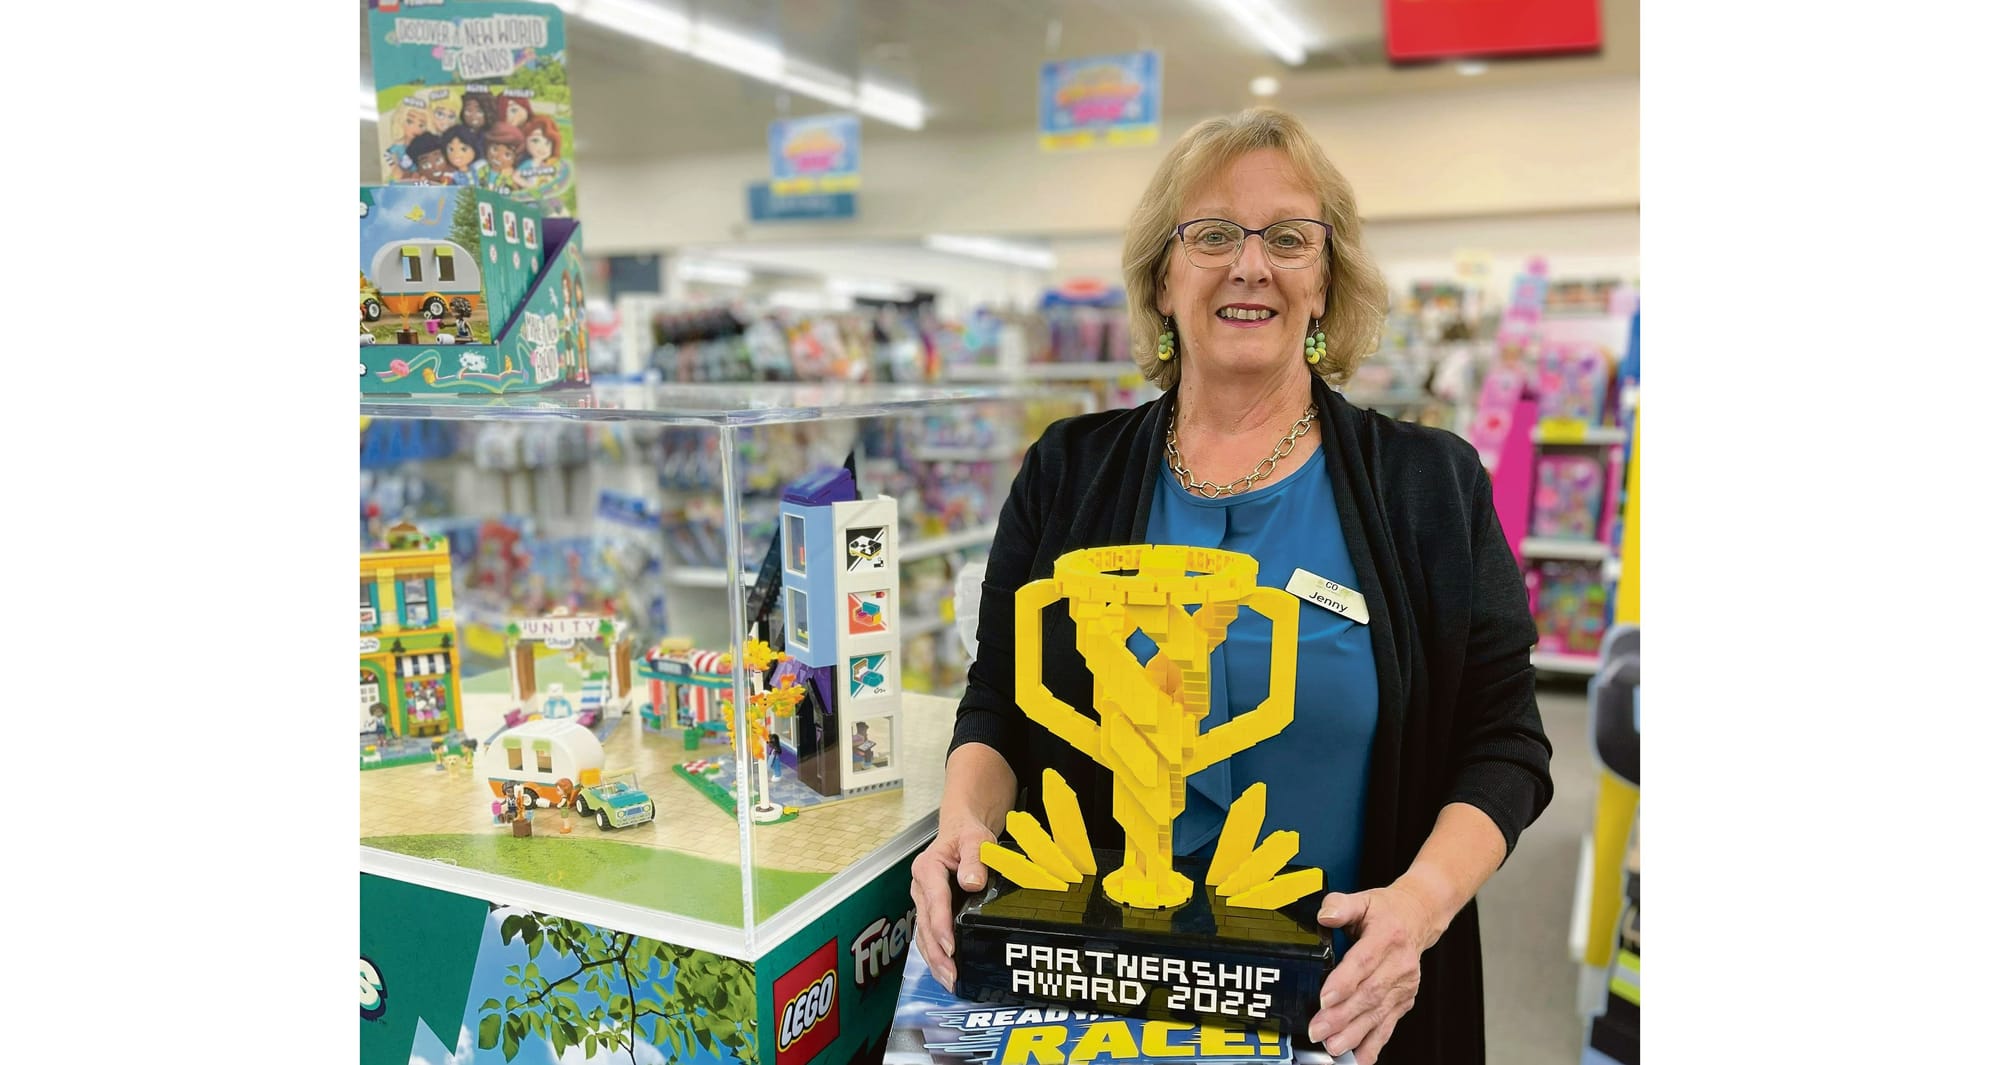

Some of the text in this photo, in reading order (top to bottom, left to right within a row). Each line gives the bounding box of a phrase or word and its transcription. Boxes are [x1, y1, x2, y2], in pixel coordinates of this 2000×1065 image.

[399, 19, 448, 43] DISCOVER
[464, 21, 494, 46] NEW
[495, 18, 543, 45] WORLD
[458, 50, 511, 76] FRIENDS
[1308, 591, 1349, 613] Jenny
[528, 621, 594, 634] UNITY
[1005, 942, 1280, 991] PARTNERSHIP
[780, 972, 835, 1049] LEGO
[1012, 969, 1272, 1018] AWARD 2022
[1001, 1020, 1281, 1065] RACE!
